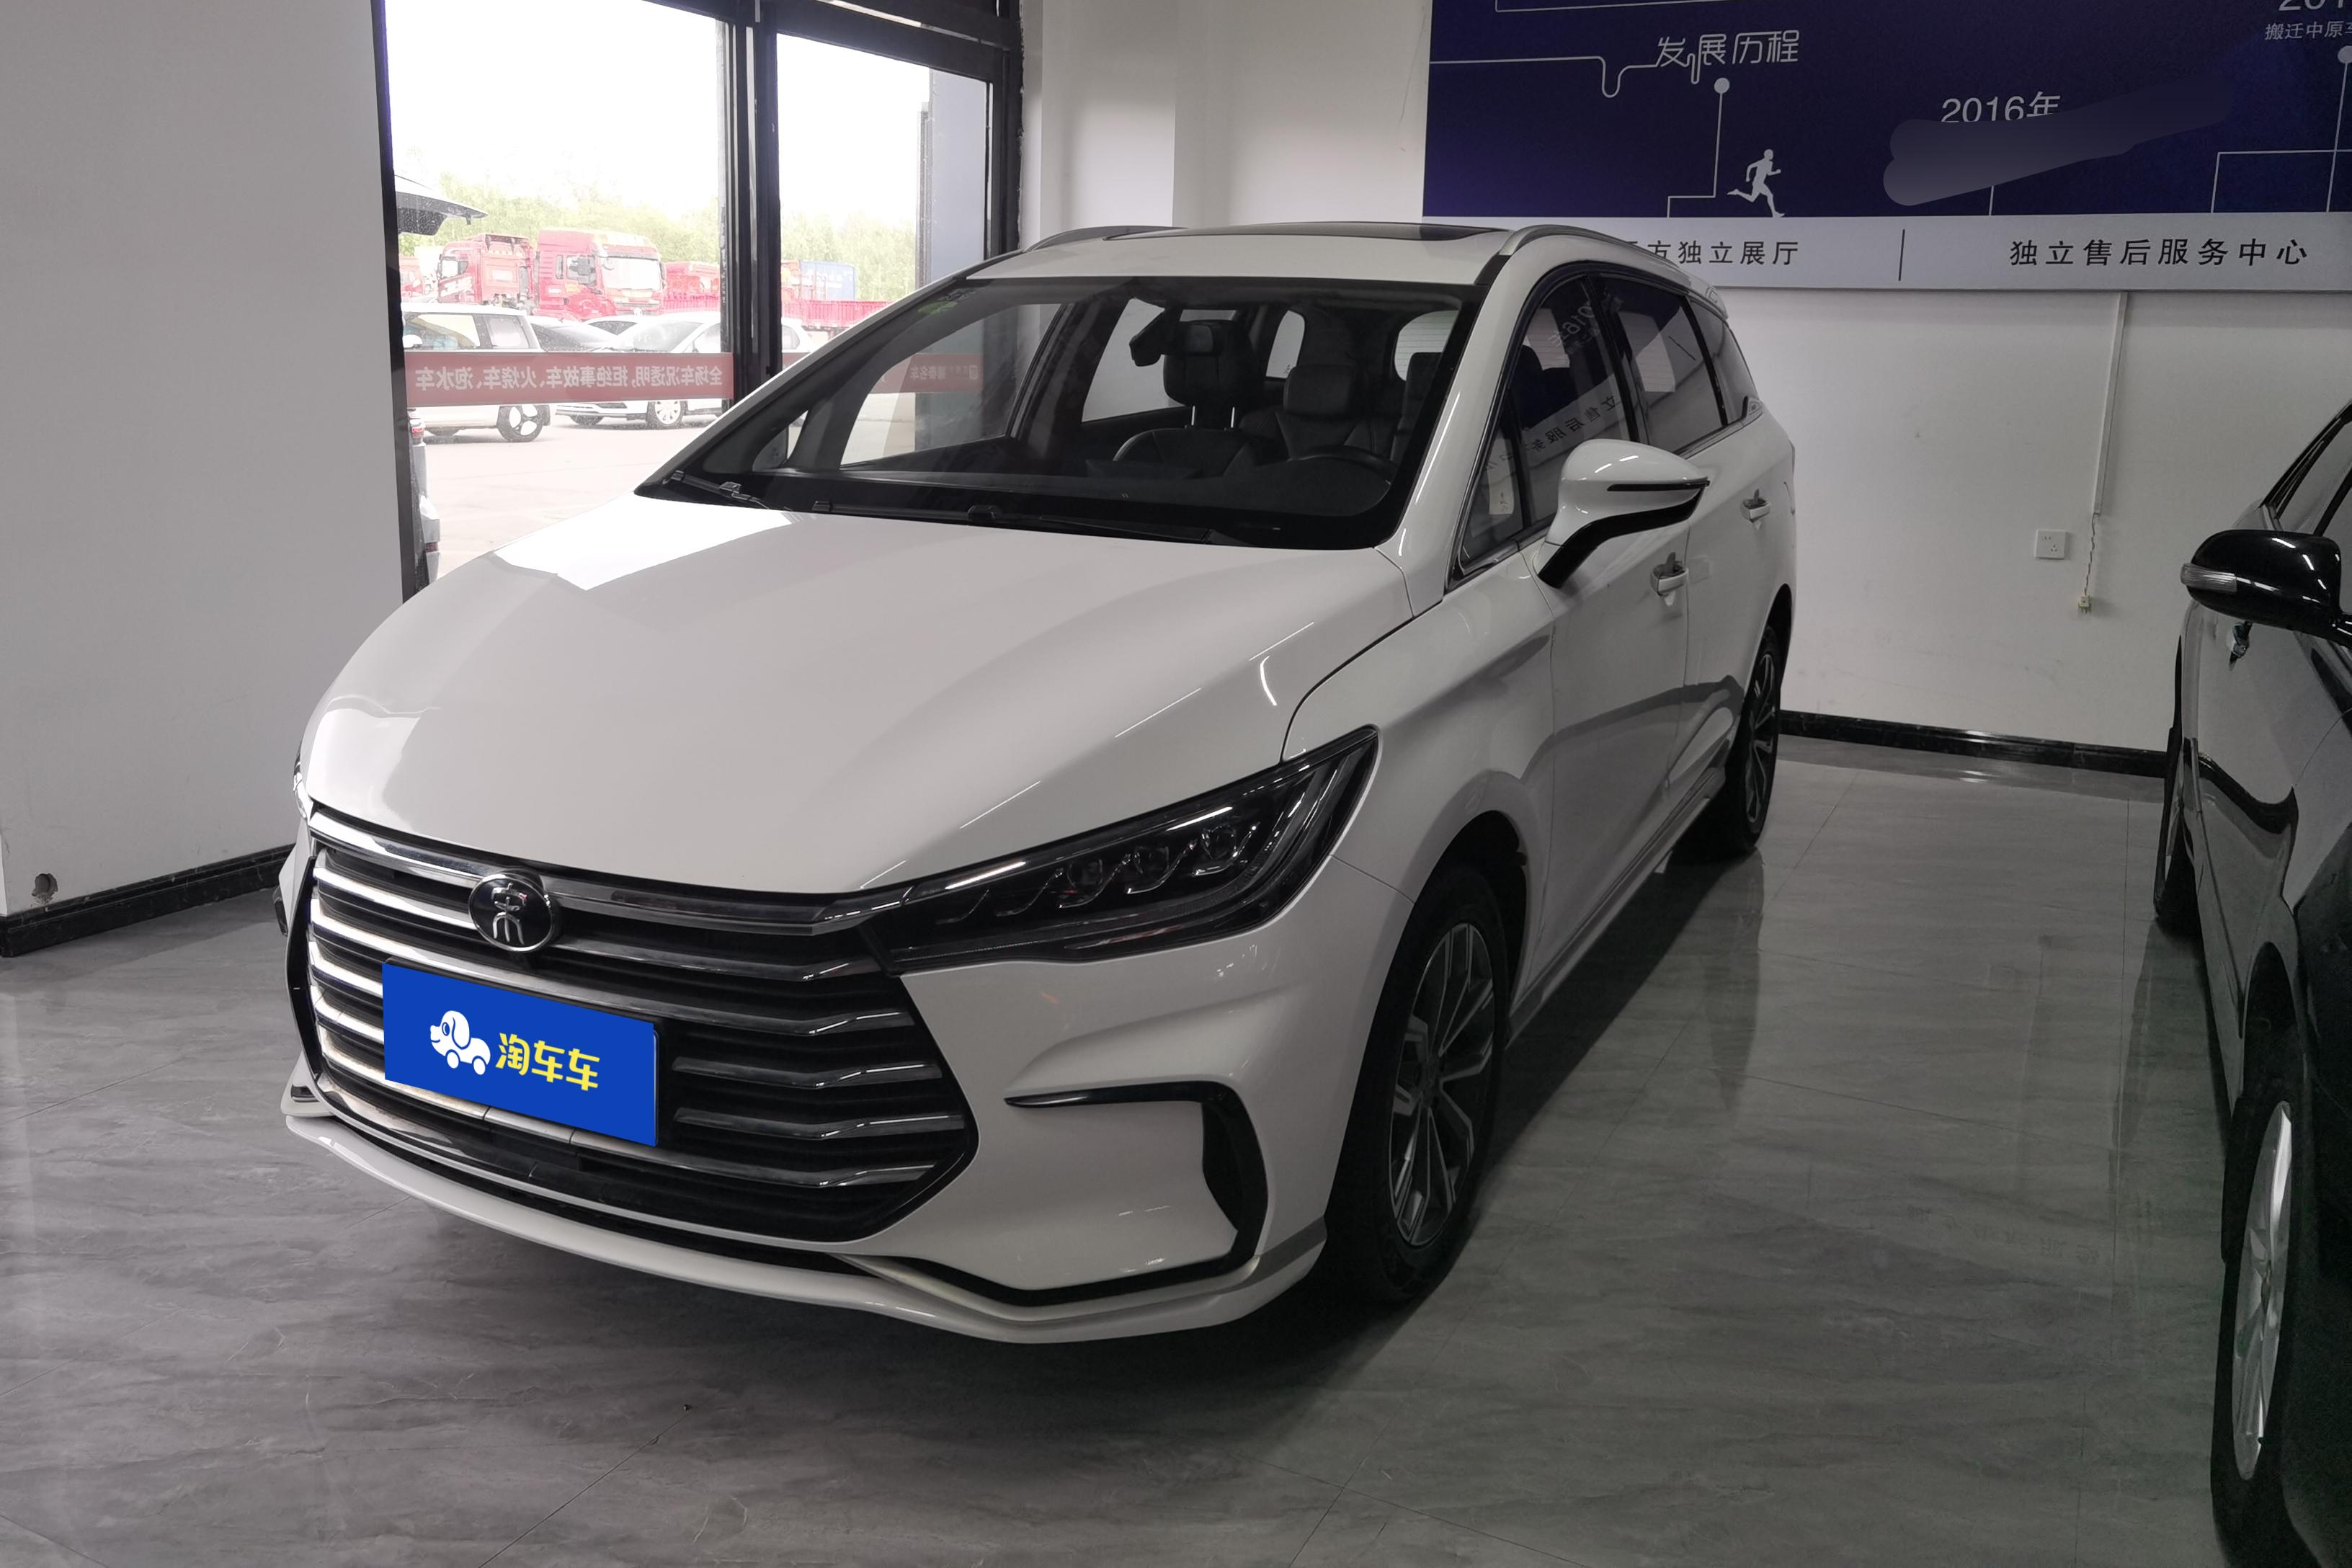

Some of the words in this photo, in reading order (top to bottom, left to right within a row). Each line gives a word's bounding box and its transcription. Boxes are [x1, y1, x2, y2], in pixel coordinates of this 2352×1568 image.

[1657, 30, 1800, 68] 发展历程
[1940, 91, 2061, 123] 2016年
[1626, 240, 1799, 265] 方独立展厅
[2009, 238, 2308, 267] 独立售后服务中心
